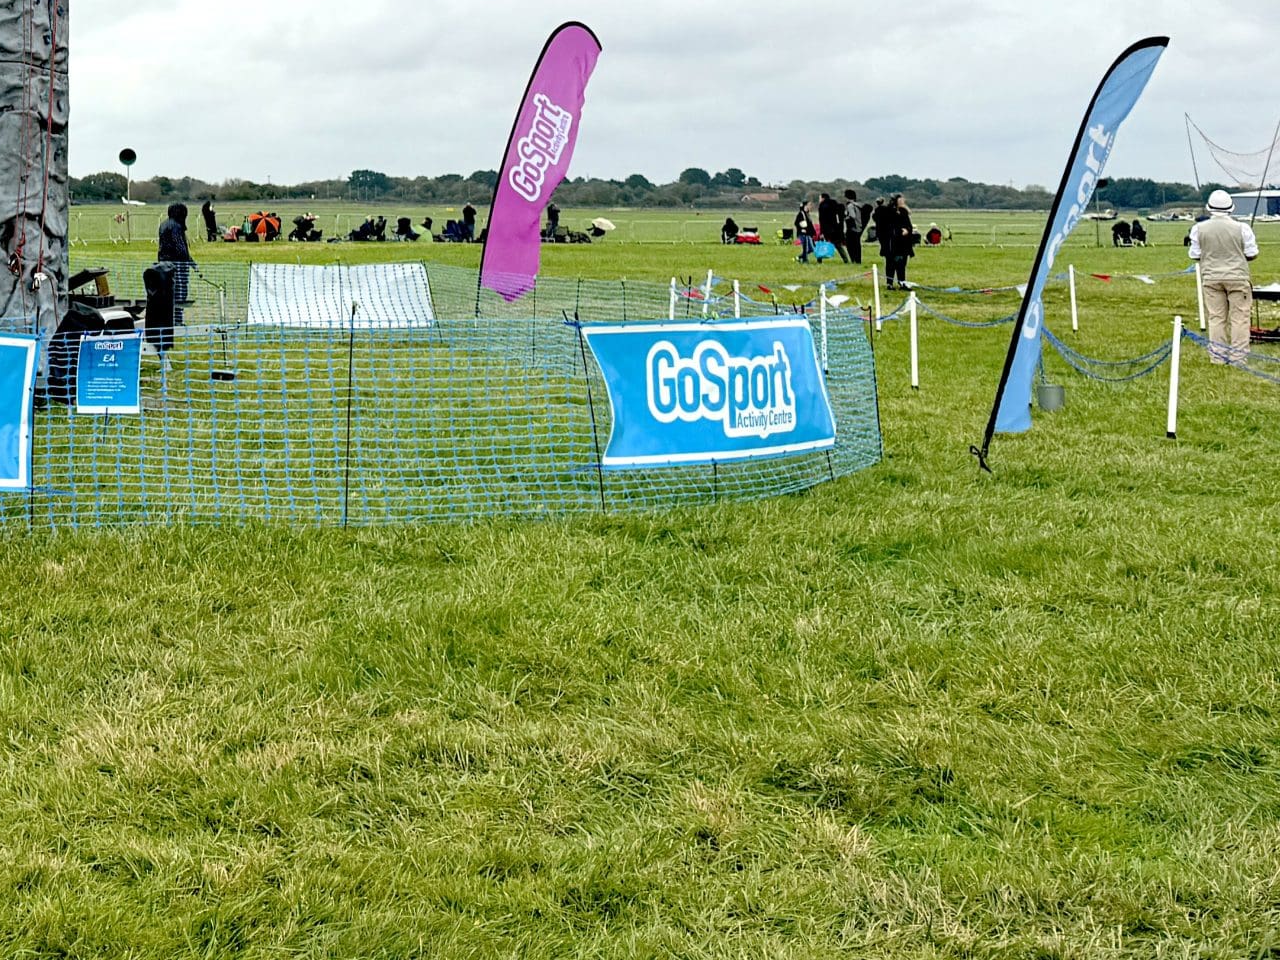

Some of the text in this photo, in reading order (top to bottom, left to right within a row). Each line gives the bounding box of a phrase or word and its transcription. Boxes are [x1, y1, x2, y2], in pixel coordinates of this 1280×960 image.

[513, 97, 561, 197] GoSport
[651, 347, 792, 429] GoSport
[737, 410, 793, 431] Activity Centre
